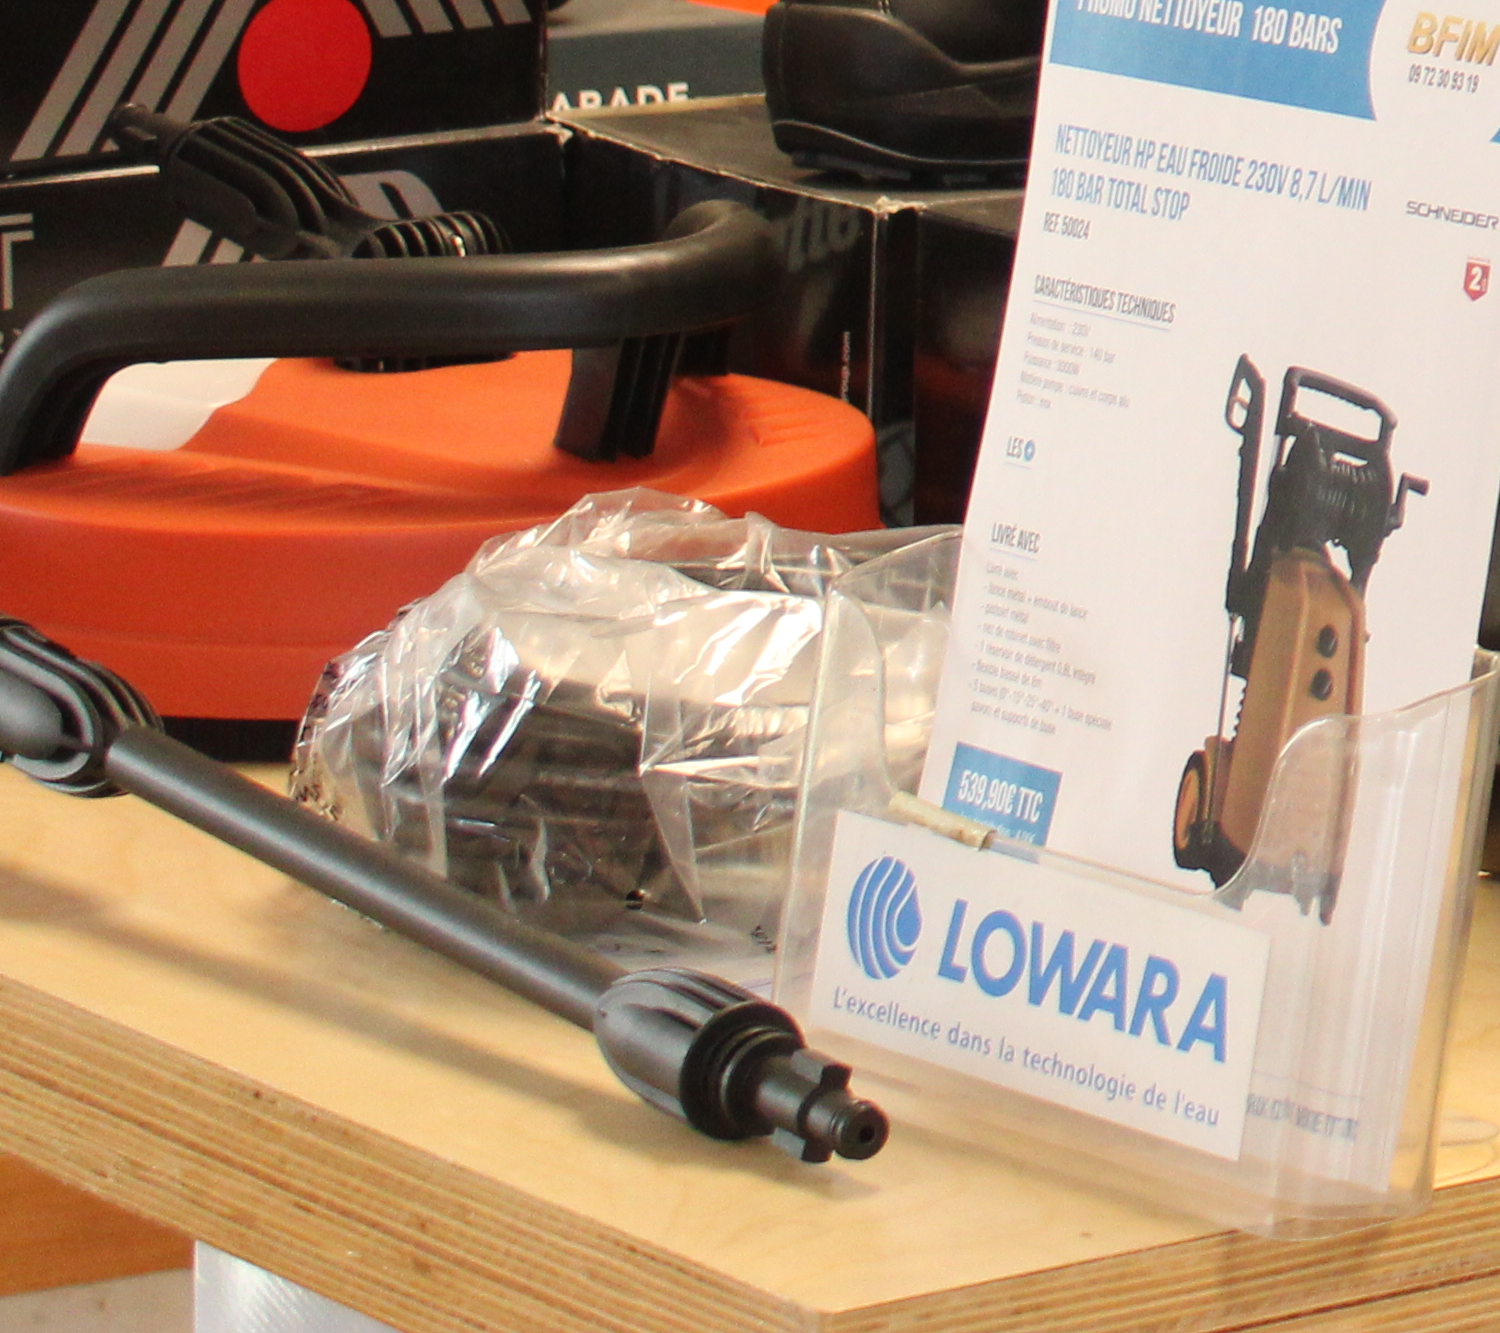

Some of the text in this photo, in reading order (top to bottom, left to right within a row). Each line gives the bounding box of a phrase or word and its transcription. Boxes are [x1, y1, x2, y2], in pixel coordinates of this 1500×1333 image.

[1251, 4, 1289, 46] 180
[1288, 10, 1343, 55] BARS
[1408, 63, 1479, 93] 09 72 30 93 19
[1056, 123, 1373, 212] NETTOYEUR HP EAU FROIDE 230V 8,7 L/MIN
[1051, 167, 1191, 222] 180 BAR TOTAL STOP
[1405, 200, 1500, 230] SCHNEIDER
[1034, 273, 1177, 324] CARACTÉRISTIQUES TECHNIQUES
[1006, 436, 1024, 459] LES
[991, 522, 1041, 554] LIVRÉ AVEC
[958, 769, 1044, 824] 539,90€ TTC
[937, 897, 1229, 1065] LOWARA
[832, 985, 941, 1041] L'excellence
[947, 1021, 992, 1056] dans
[998, 1035, 1016, 1064] la
[1022, 1047, 1137, 1103] technologie
[1143, 1082, 1168, 1110] de
[1173, 1089, 1220, 1127] l'eau
